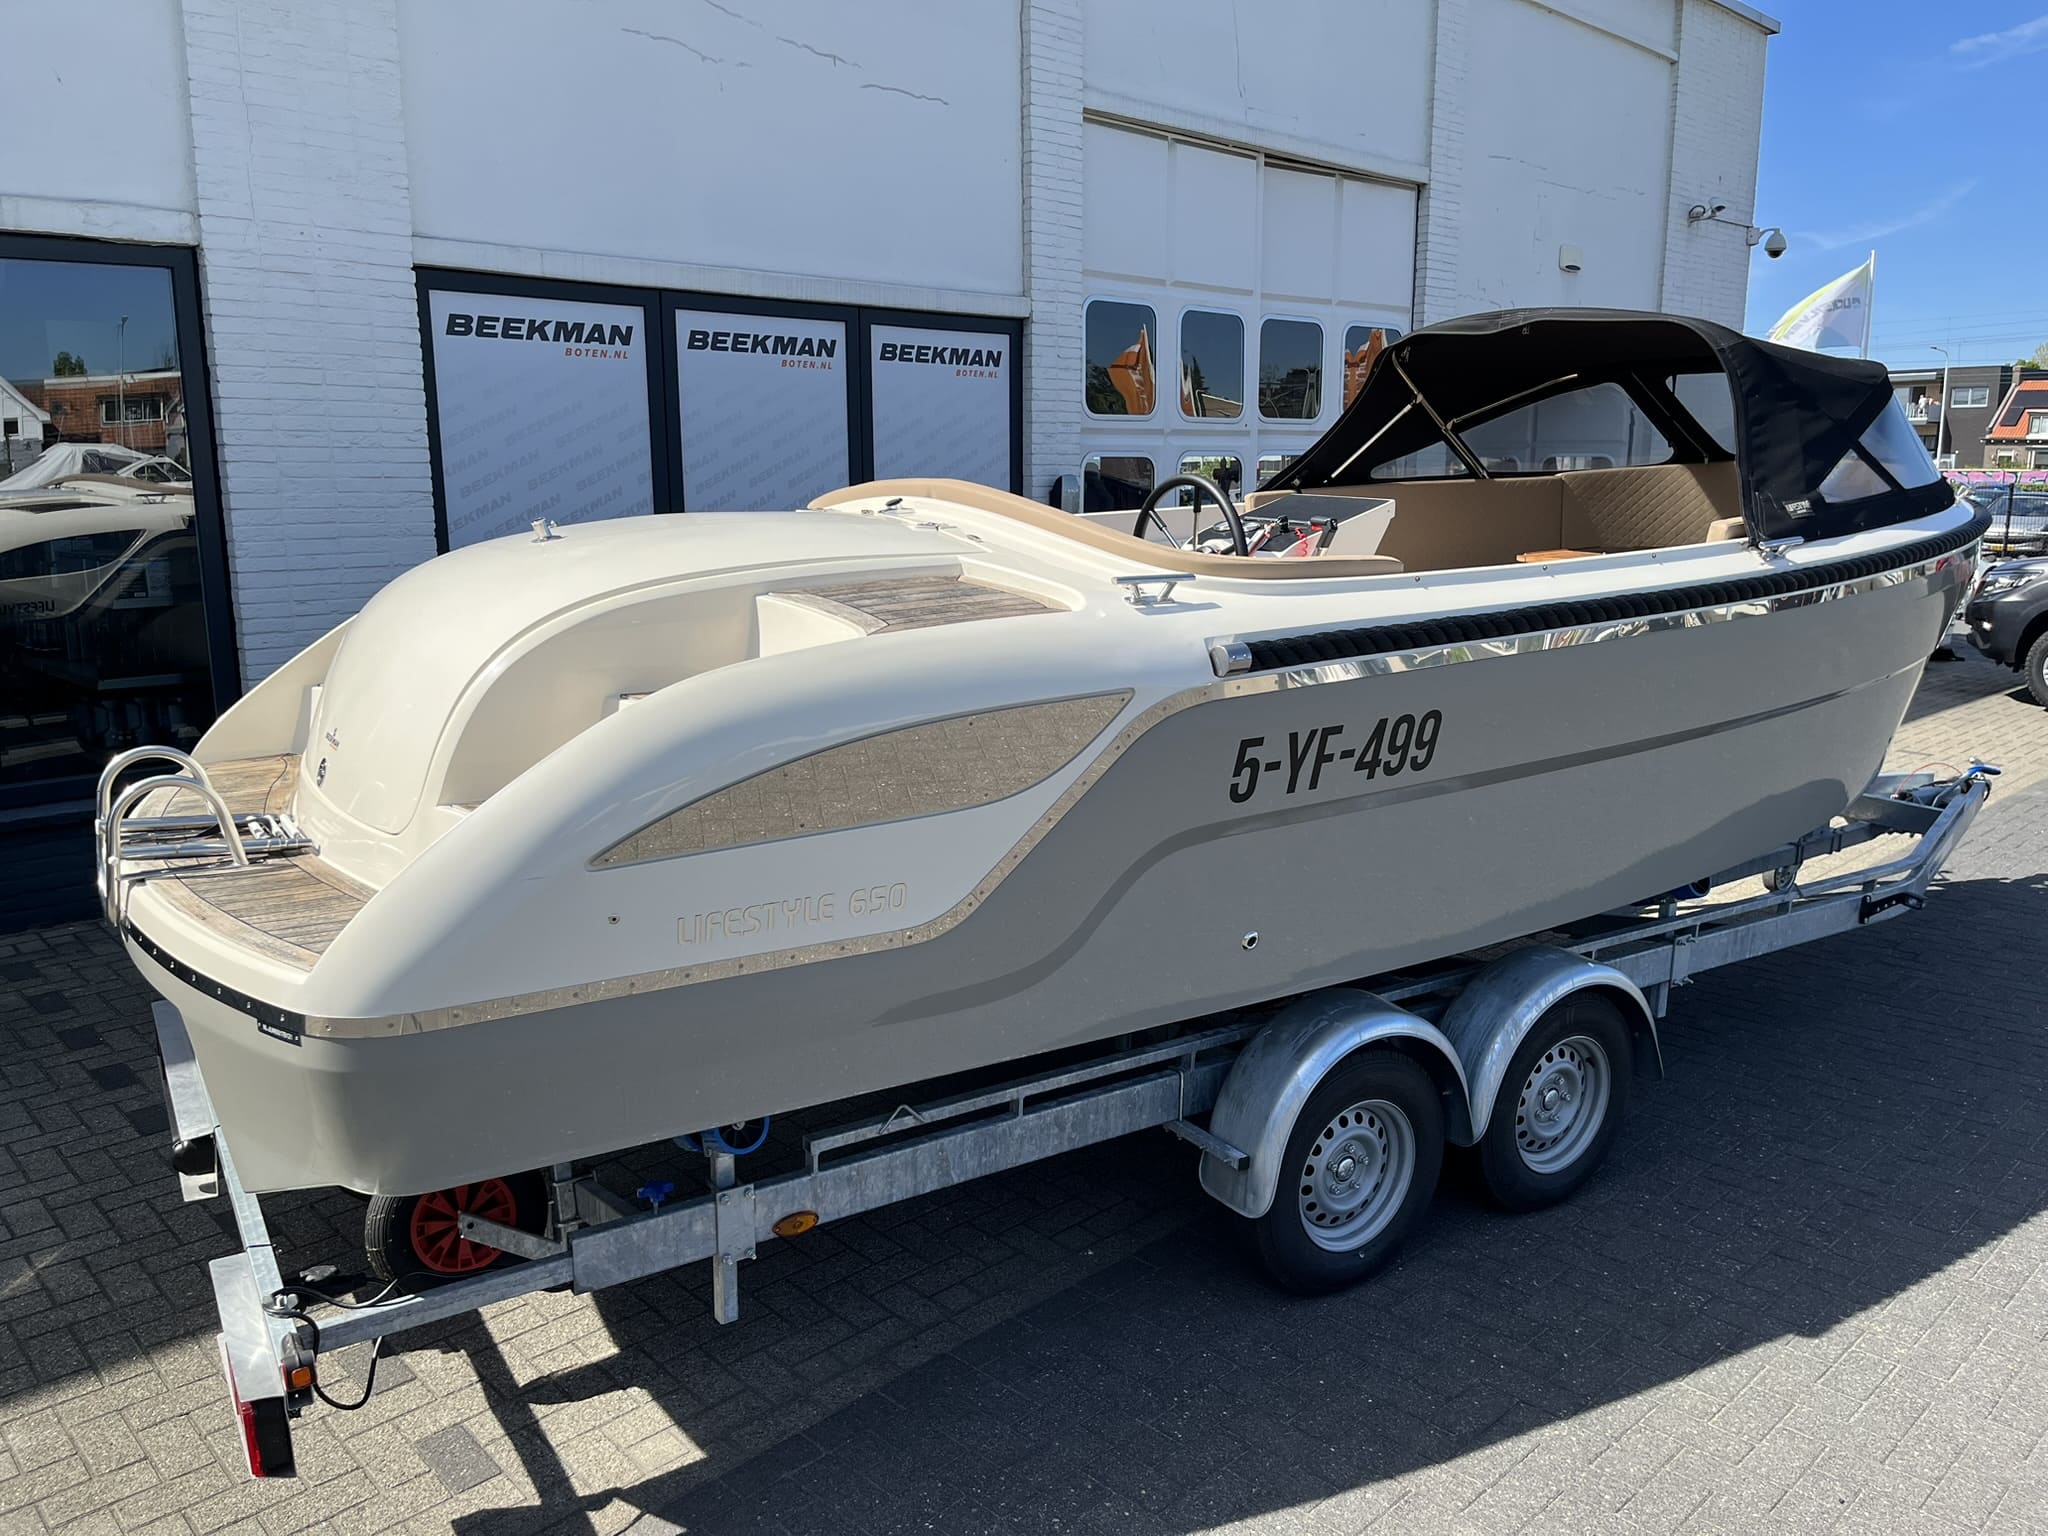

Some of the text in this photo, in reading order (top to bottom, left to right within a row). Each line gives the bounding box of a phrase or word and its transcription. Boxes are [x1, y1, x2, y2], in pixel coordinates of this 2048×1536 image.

[446, 313, 633, 346] BEEKMAN
[687, 329, 837, 358] BEEKMAN
[565, 348, 629, 359] BOTEN.NL
[781, 359, 833, 370] BOTEN.NL
[879, 342, 1002, 368] BEEKMAN
[955, 369, 998, 379] BOTEN.NL
[460, 448, 539, 499] BEEKMAN
[527, 441, 603, 491] BEEKMAN
[1229, 709, 1443, 804] 5-YF-499
[677, 882, 908, 945] LIFESTYLE 650
